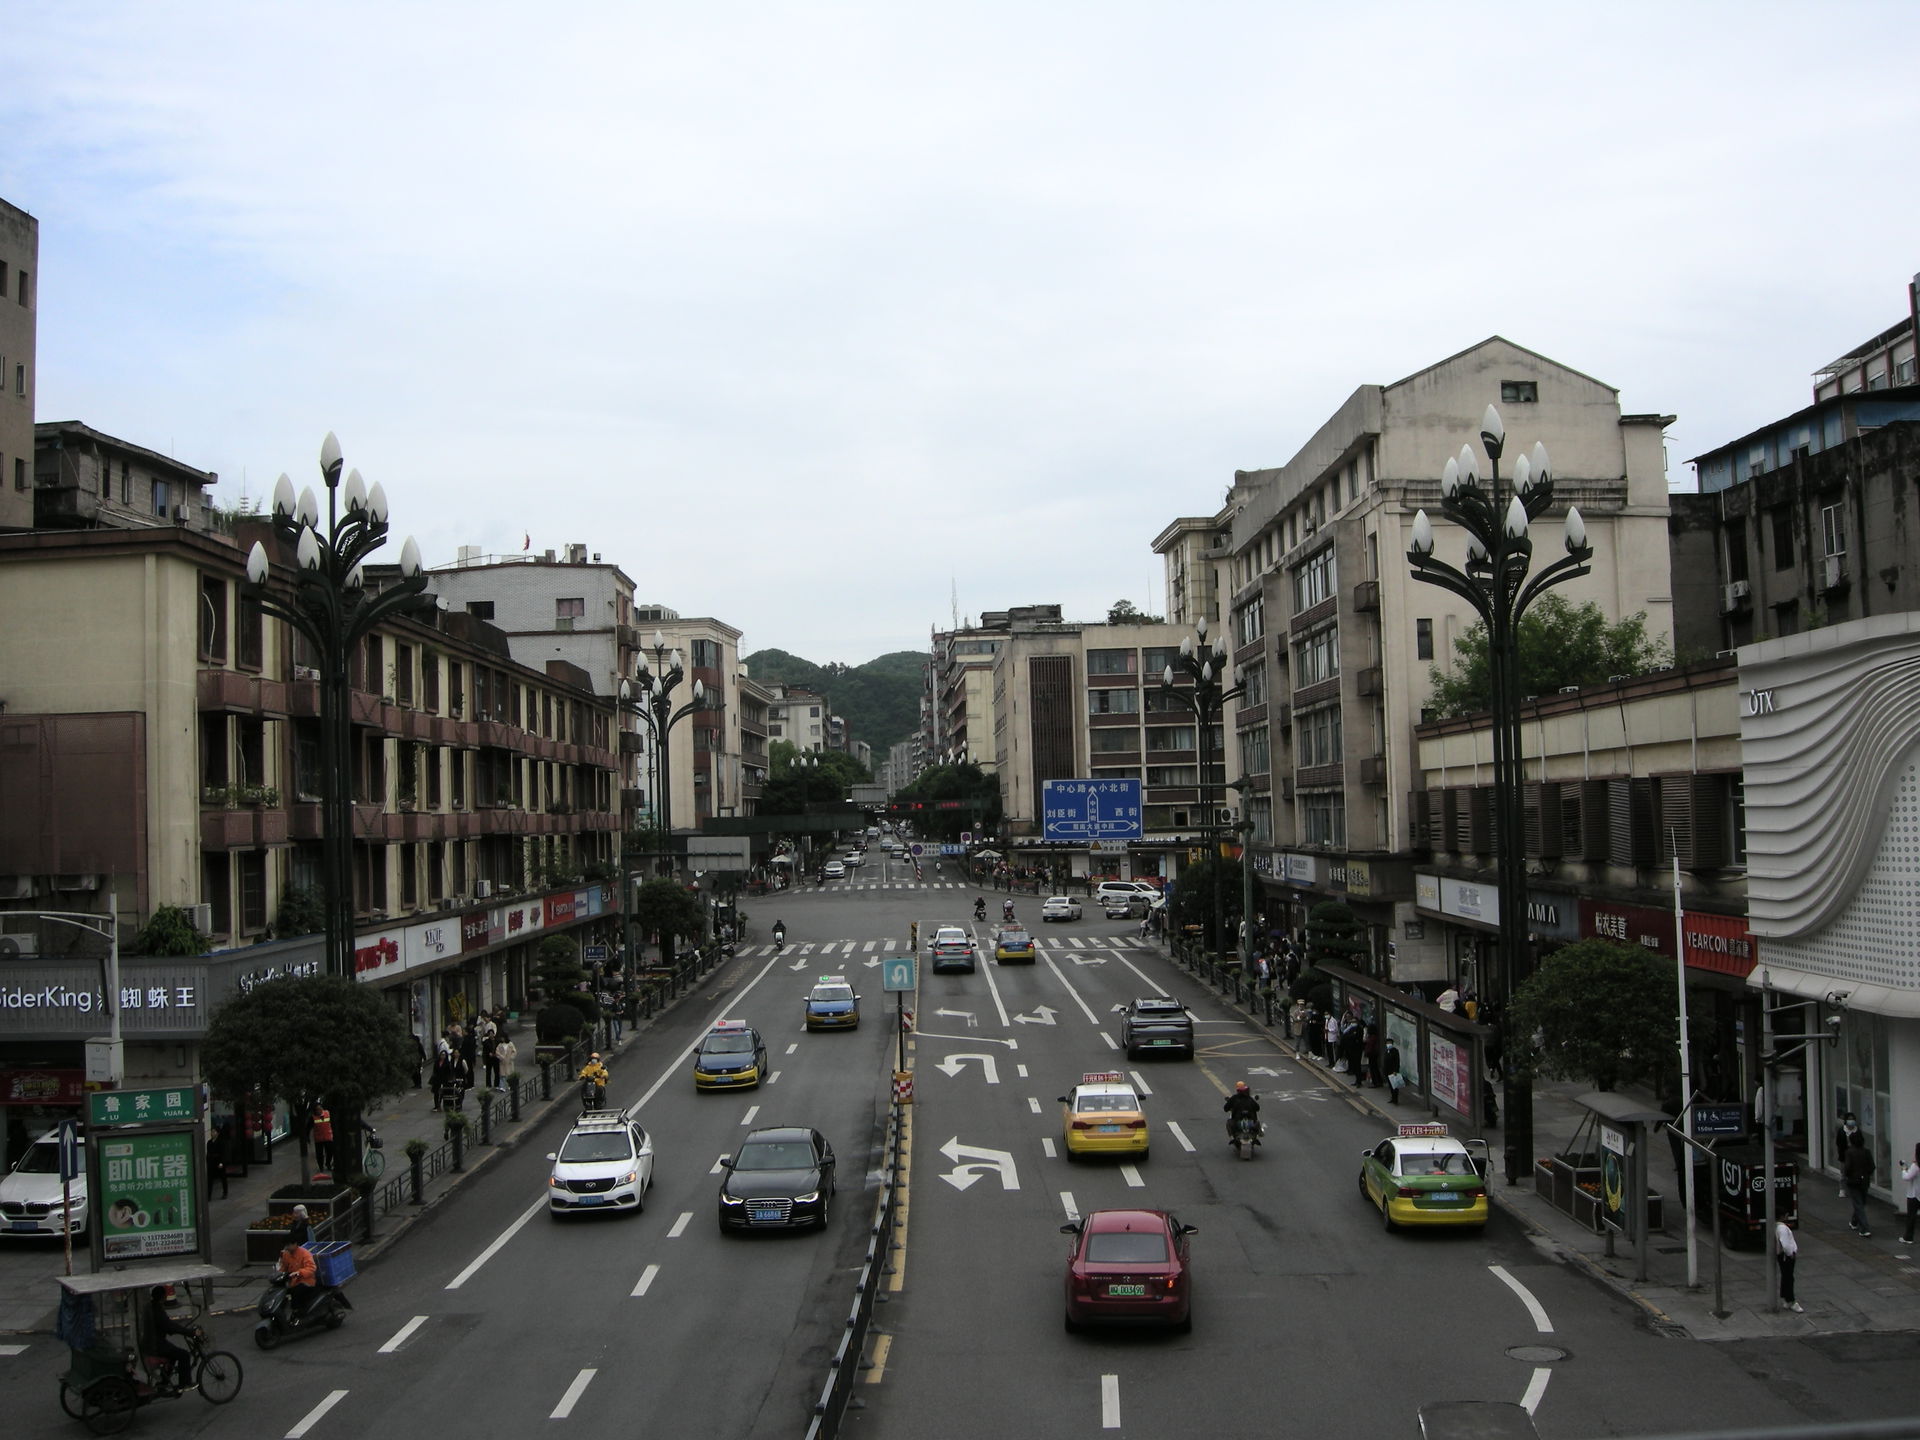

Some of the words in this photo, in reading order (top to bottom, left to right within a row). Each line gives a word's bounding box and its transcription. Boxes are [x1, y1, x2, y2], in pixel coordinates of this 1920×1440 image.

[1056, 784, 1086, 793] 中心路
[1099, 783, 1129, 793] 小北街
[1114, 807, 1138, 817] 西街
[1686, 931, 1728, 953] YEARCON
[0, 986, 92, 1012] iderKing
[121, 986, 196, 1009] 蜘蛛王
[105, 1092, 182, 1113] 鲁家园
[108, 1154, 188, 1181] 助听器
